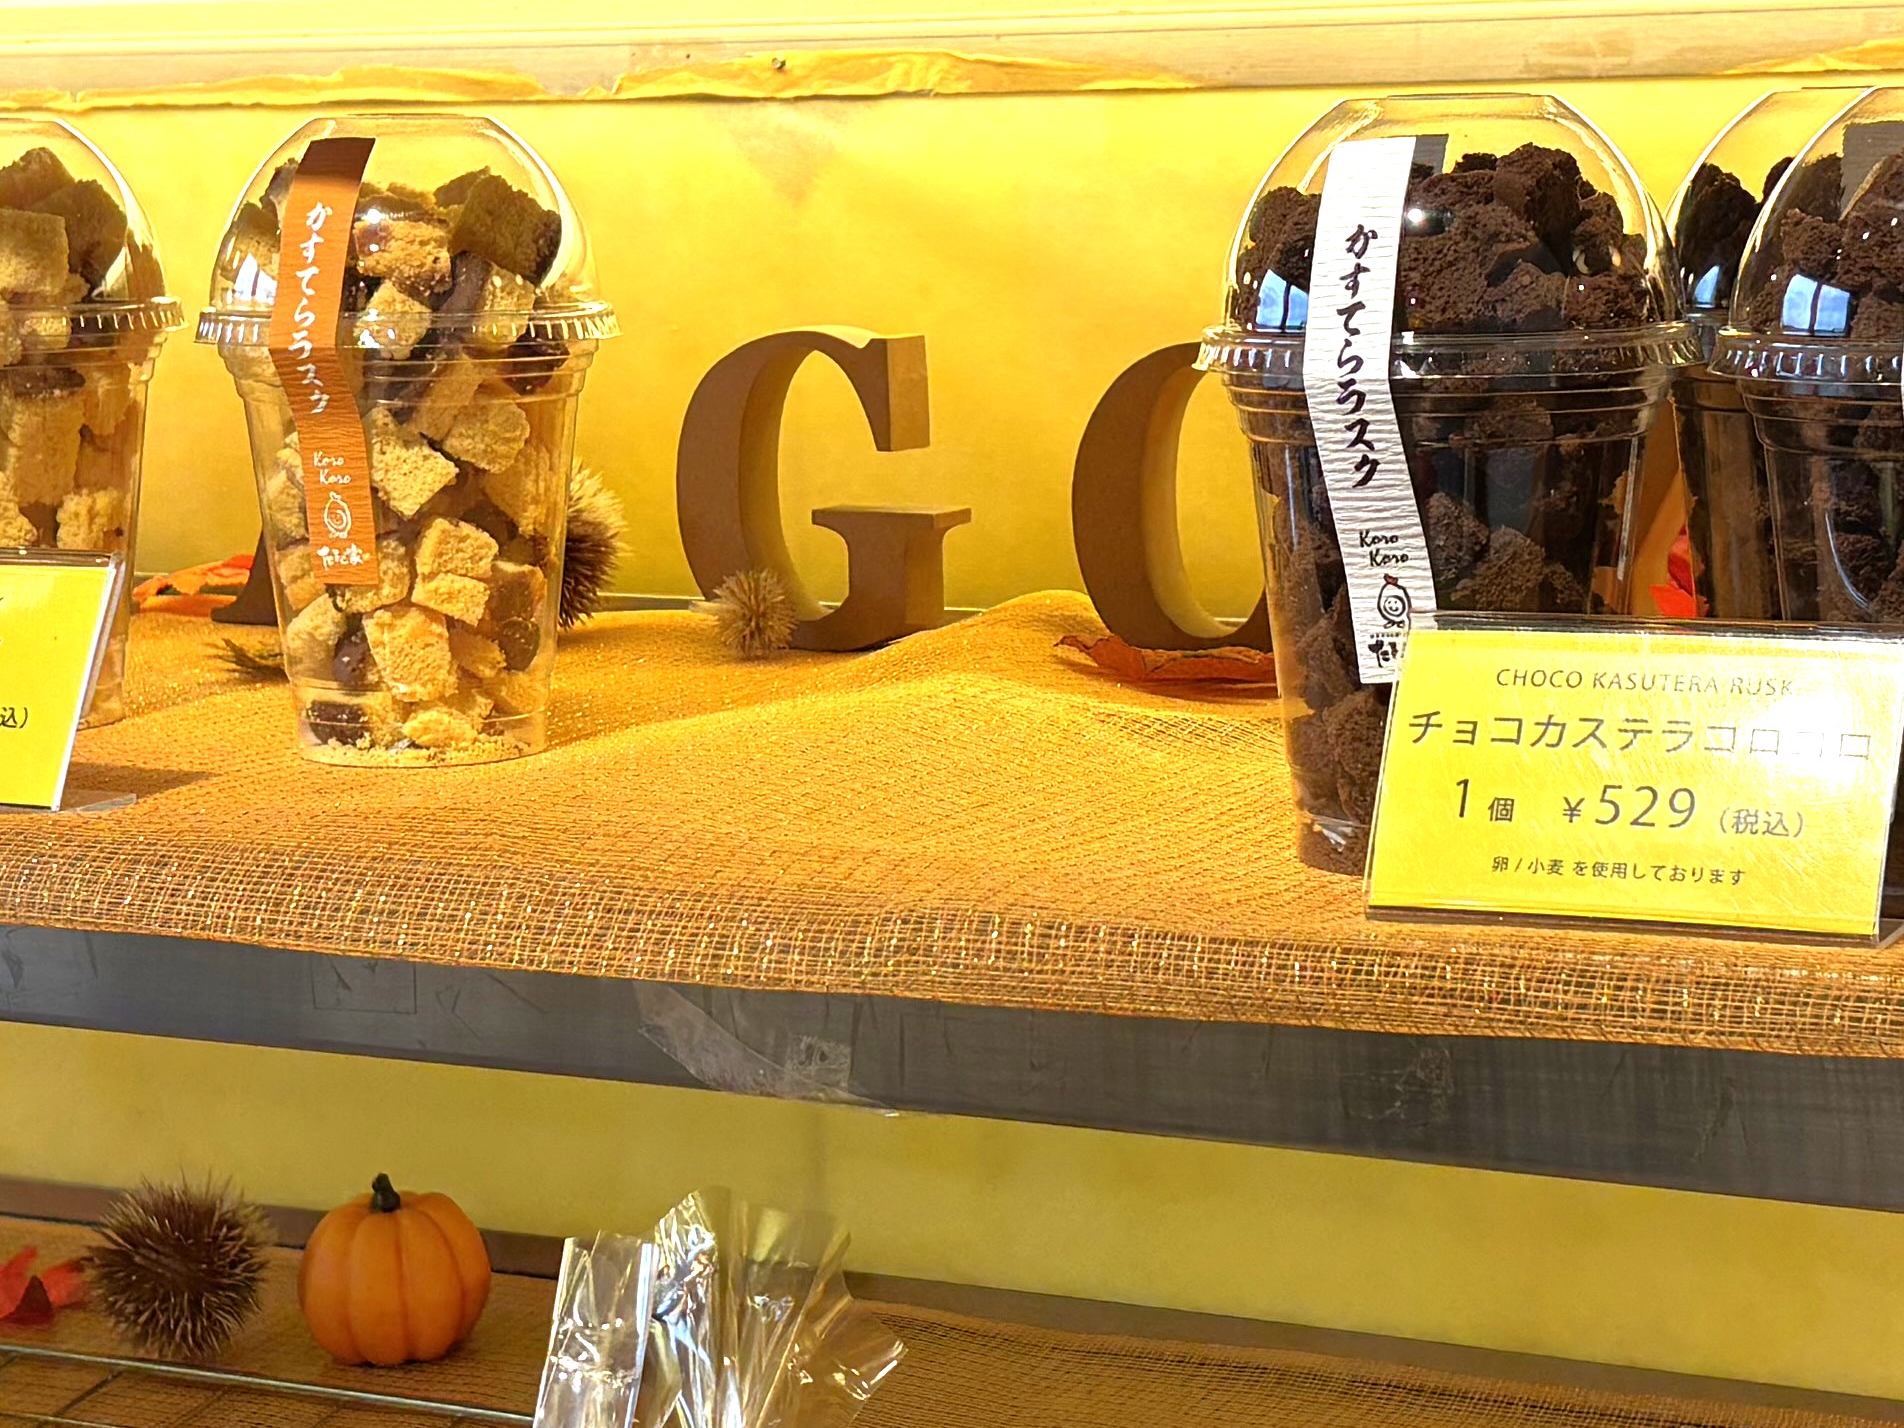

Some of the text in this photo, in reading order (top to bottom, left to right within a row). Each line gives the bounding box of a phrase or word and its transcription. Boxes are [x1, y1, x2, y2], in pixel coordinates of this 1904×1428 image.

[288, 202, 333, 413] かすてらラスク
[1334, 224, 1382, 490] かすてらラスク
[1359, 529, 1399, 548] Koro
[1369, 549, 1409, 567] Koro
[1496, 668, 1797, 697] CHOCO KASUTERA RUSK
